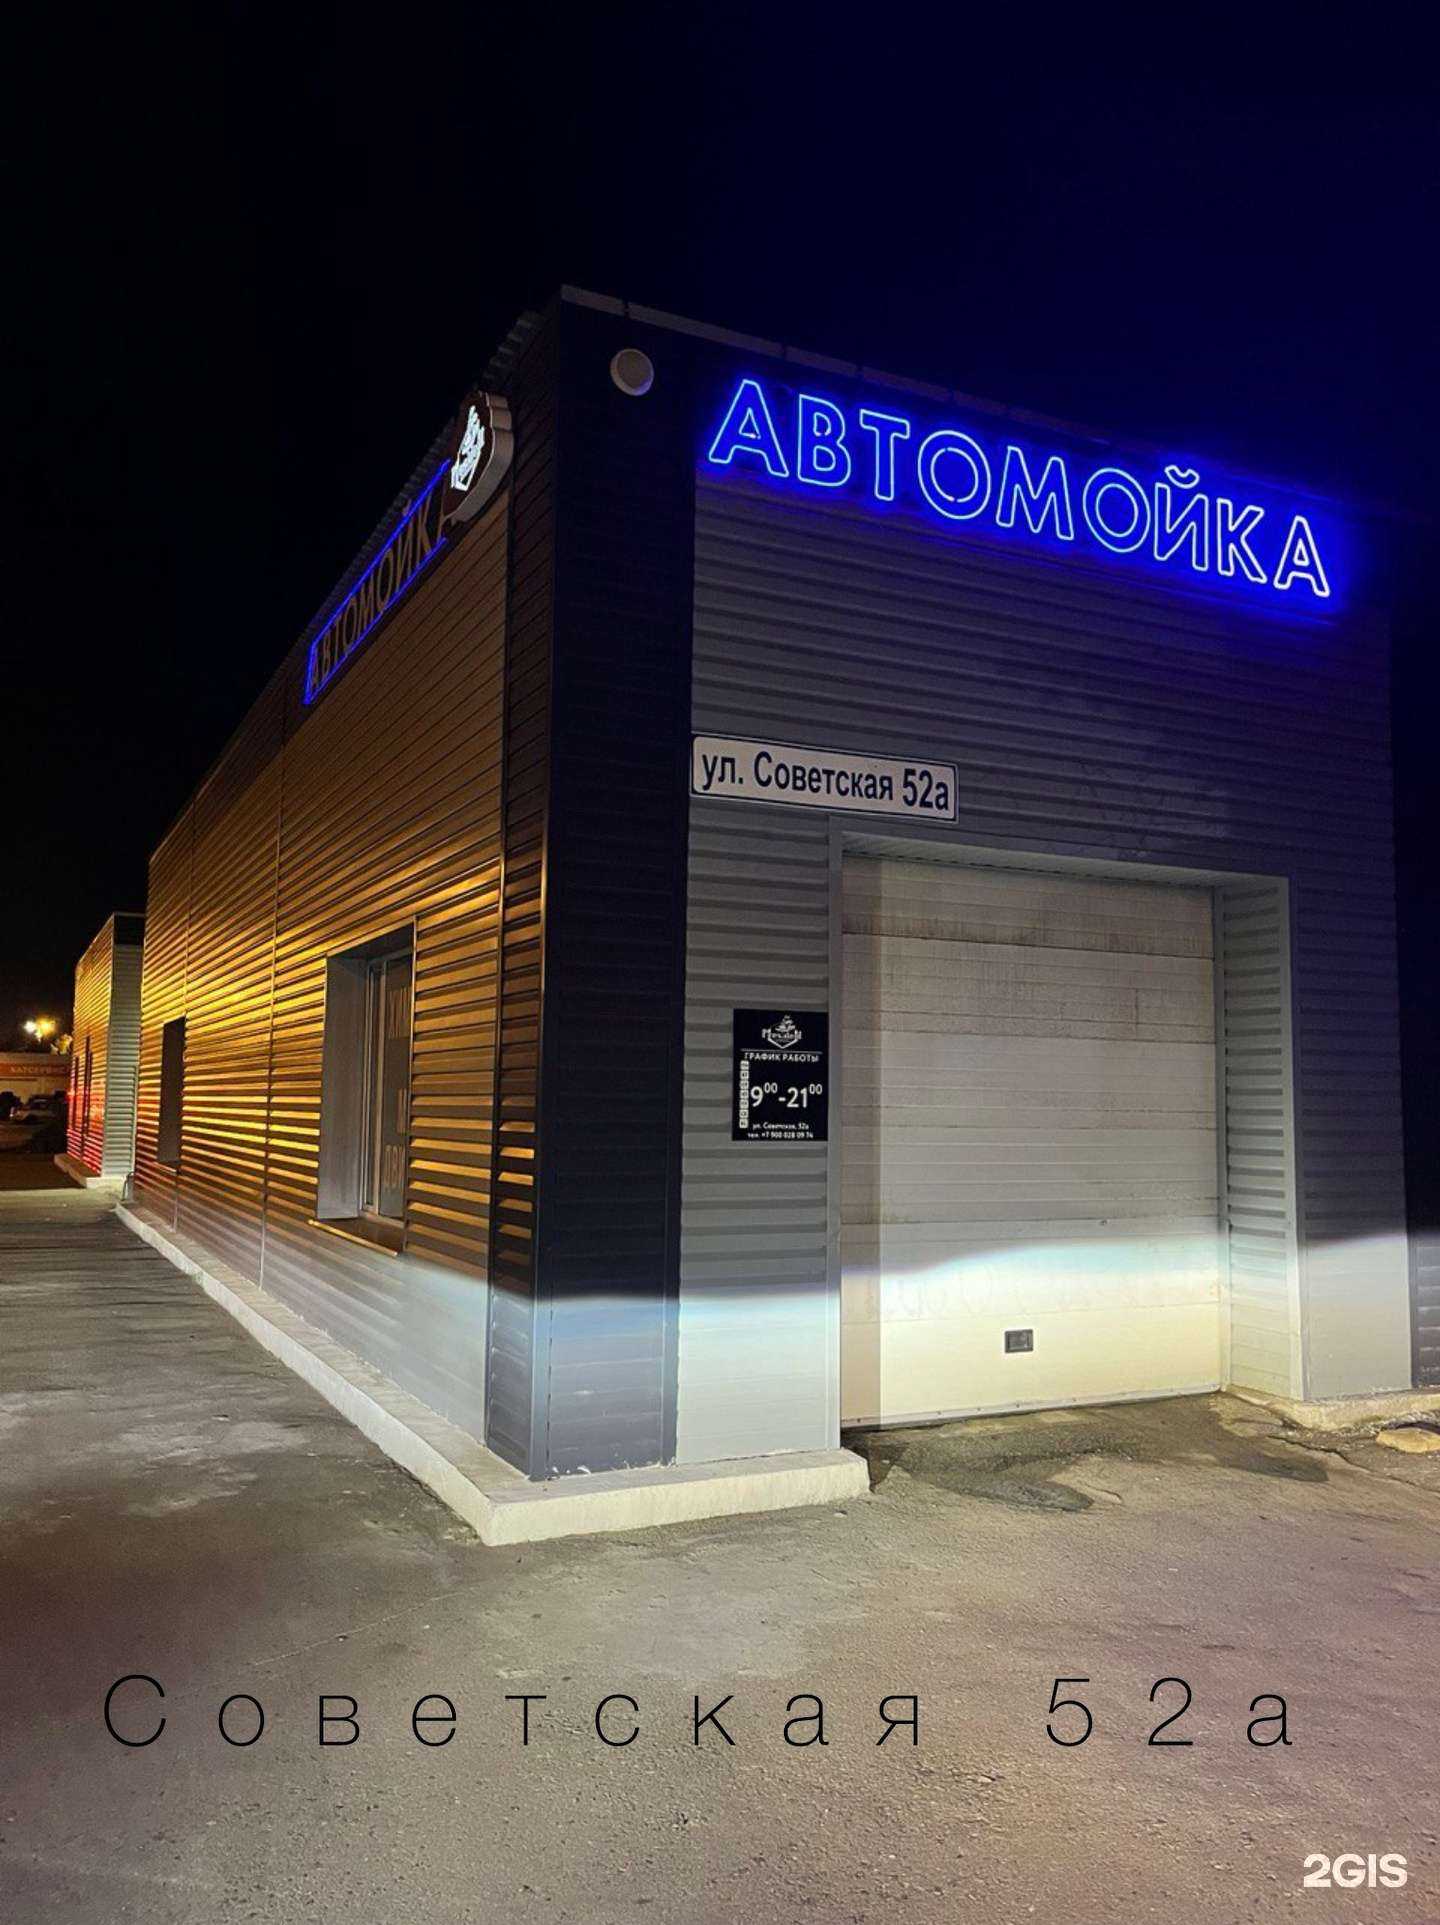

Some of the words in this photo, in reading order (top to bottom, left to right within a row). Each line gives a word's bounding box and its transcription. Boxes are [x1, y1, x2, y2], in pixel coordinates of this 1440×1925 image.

[708, 378, 1330, 598] АВТОМОЙКА
[701, 753, 744, 791] ул.
[753, 750, 894, 800] Советская
[902, 767, 950, 811] 52а
[744, 1052, 781, 1062] ГРАФИК
[782, 1053, 819, 1063] РАБОТЫ
